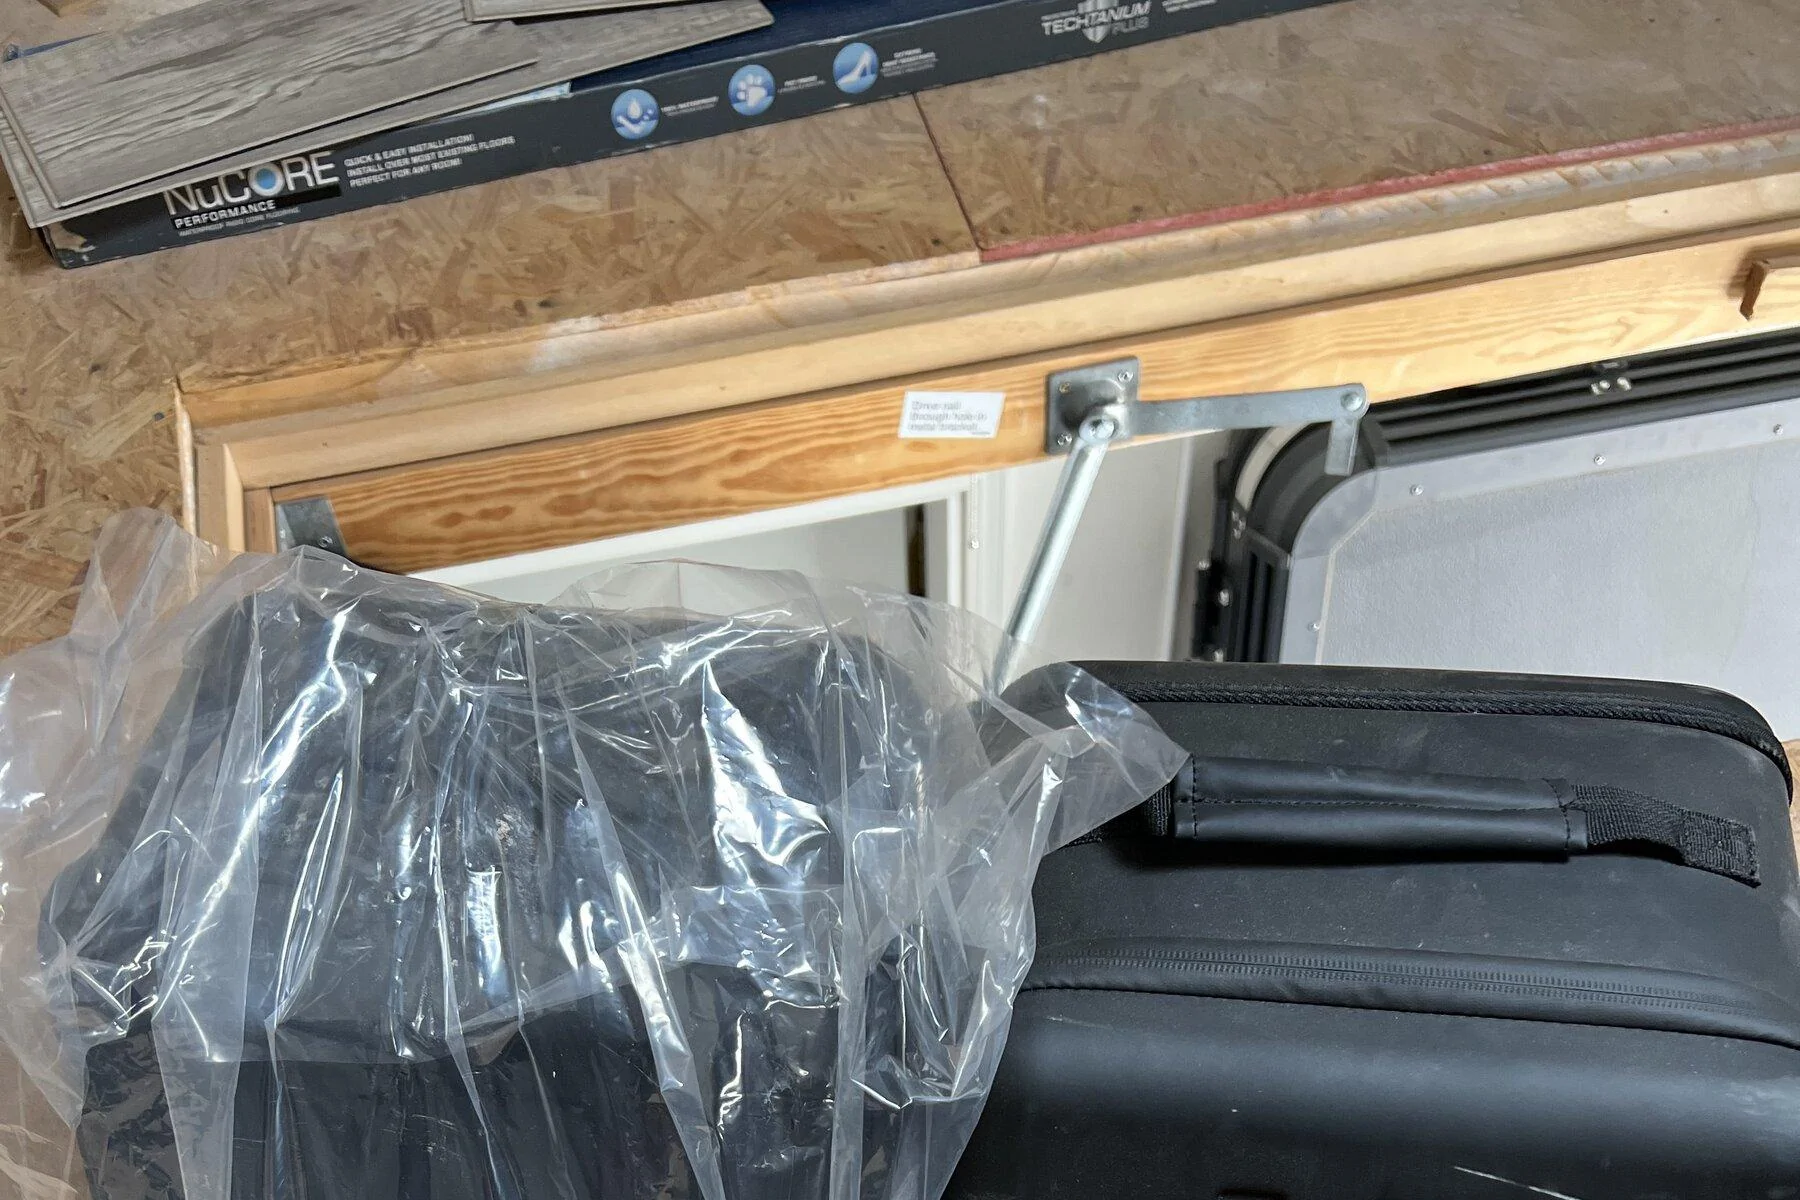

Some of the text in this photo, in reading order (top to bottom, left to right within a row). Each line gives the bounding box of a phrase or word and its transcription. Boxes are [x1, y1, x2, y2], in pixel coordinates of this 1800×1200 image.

[1041, 0, 1152, 36] TECHTANIUM
[1111, 16, 1150, 35] PLUS
[343, 155, 373, 167] QUICK
[382, 147, 407, 160] EASY
[347, 135, 516, 178] INSTALL OVER MOST EXISTING FLOORS
[162, 151, 340, 215] NuCORE
[349, 172, 391, 188] PERFECT
[391, 168, 412, 179] FOR
[411, 164, 431, 176] ANY
[174, 199, 276, 229] PERFORMANCE
